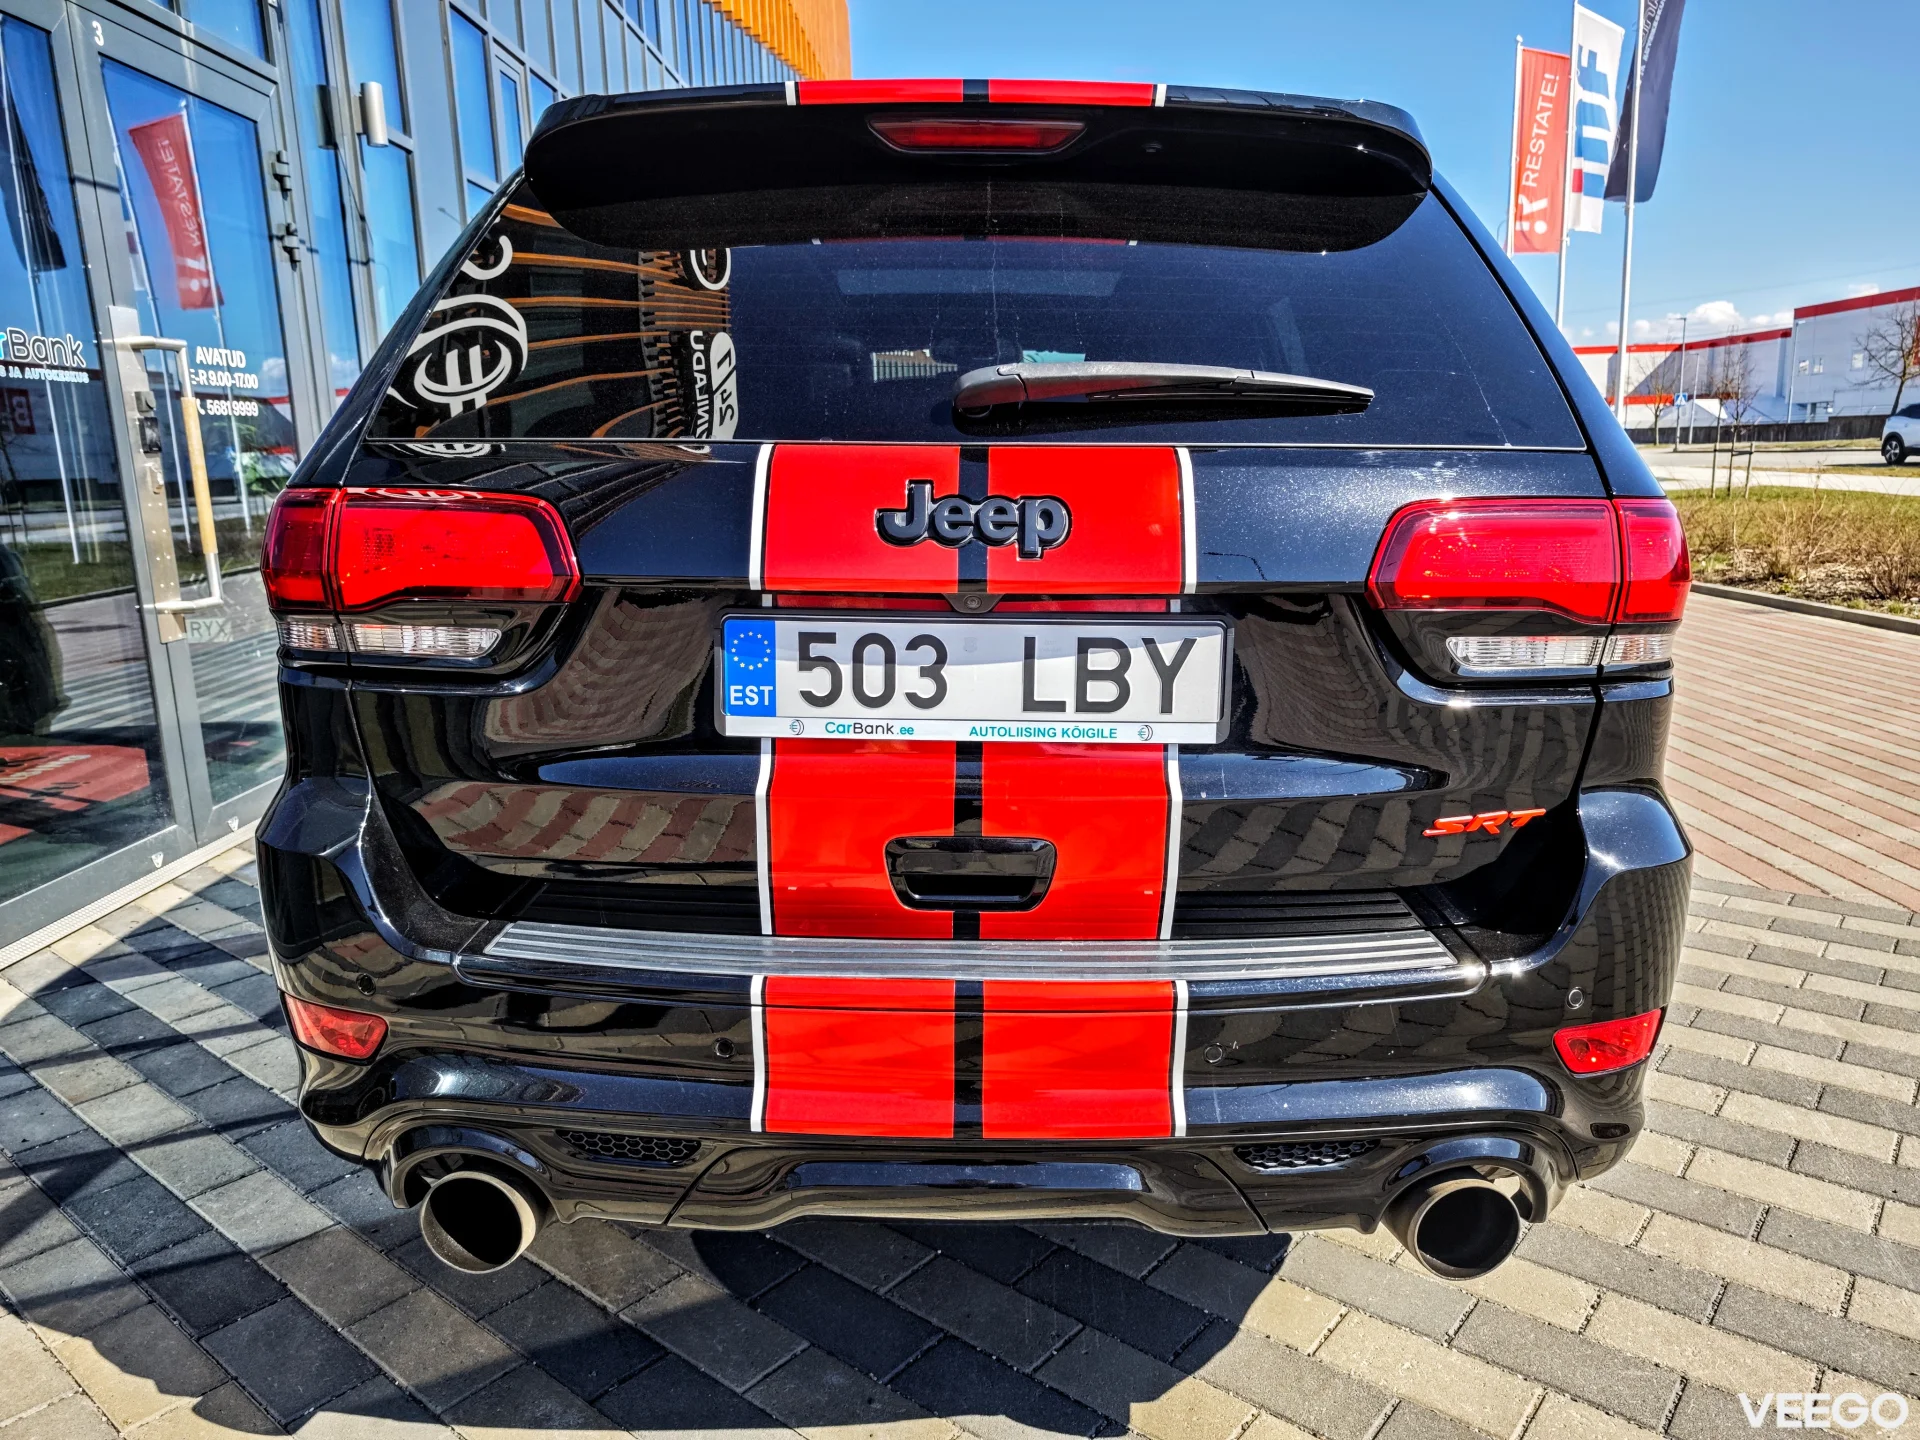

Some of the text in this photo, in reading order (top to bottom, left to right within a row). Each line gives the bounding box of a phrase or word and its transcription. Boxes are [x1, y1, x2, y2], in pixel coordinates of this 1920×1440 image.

[92, 20, 105, 47] 3
[1521, 72, 1560, 188] RESTATE!
[195, 345, 247, 369] AVATUD
[874, 479, 1073, 562] Jeep
[797, 630, 1198, 715] 503 LBY
[729, 684, 774, 707] EST
[968, 726, 1058, 739] AUTOLIISING
[1060, 725, 1118, 740] KÕIGILE
[1422, 808, 1547, 837] SRT
